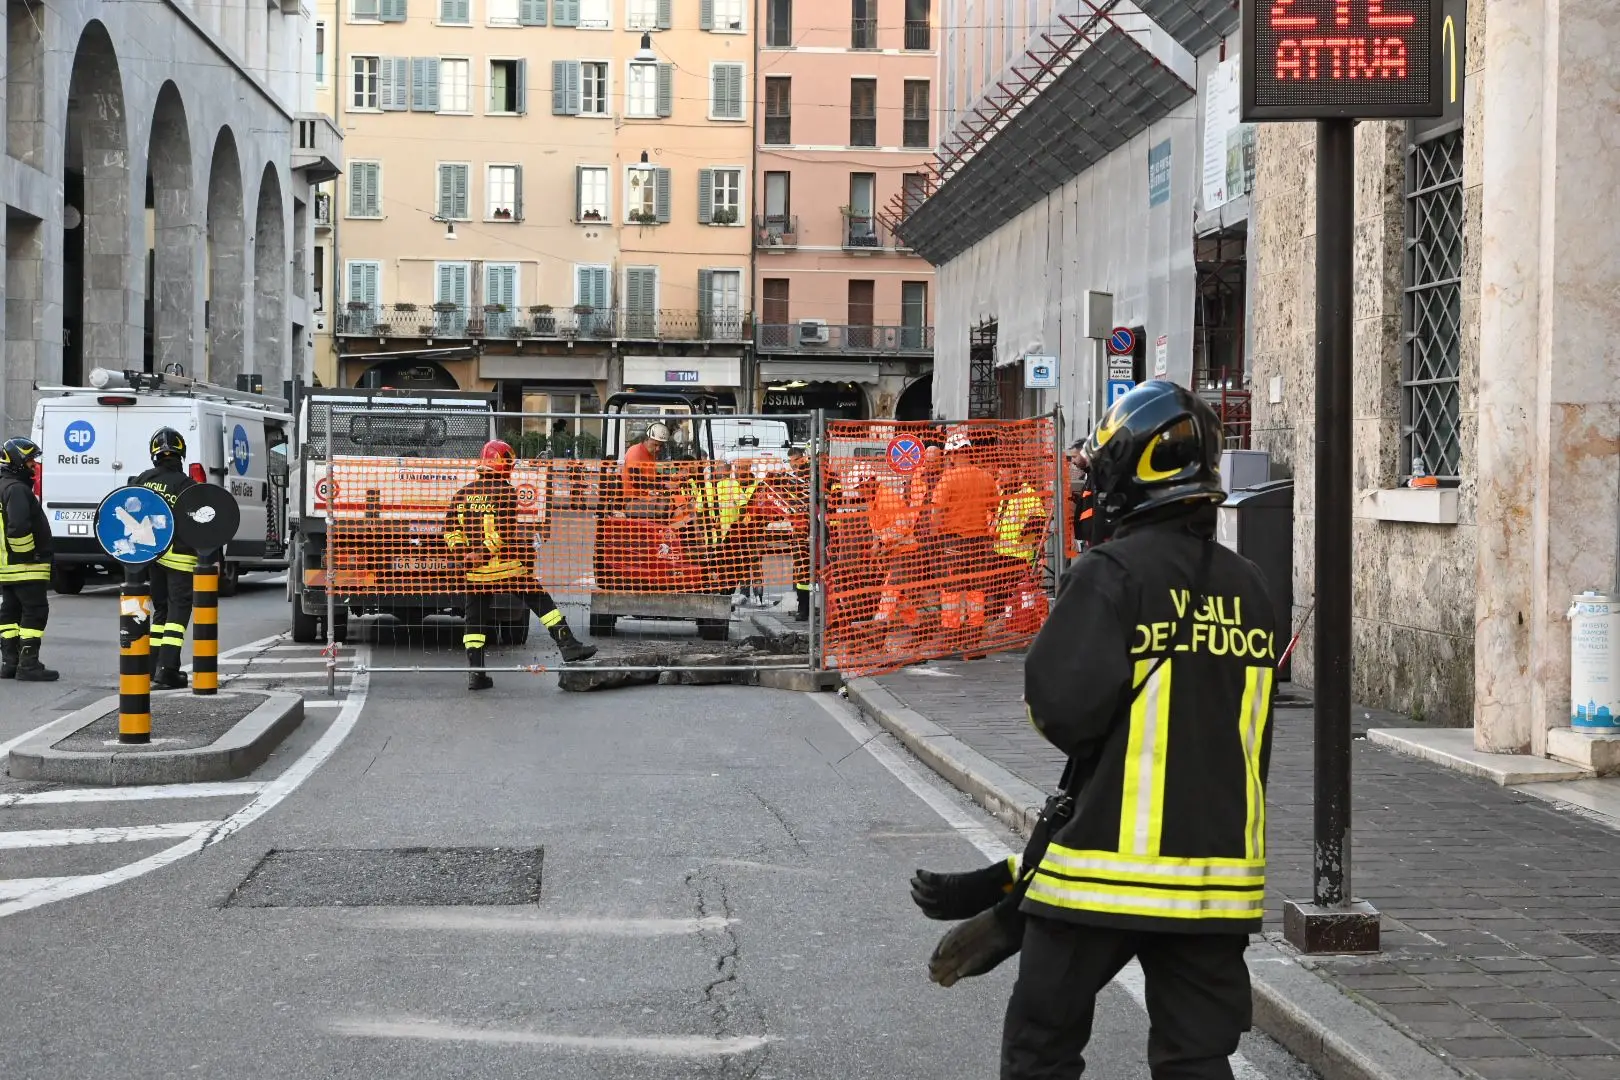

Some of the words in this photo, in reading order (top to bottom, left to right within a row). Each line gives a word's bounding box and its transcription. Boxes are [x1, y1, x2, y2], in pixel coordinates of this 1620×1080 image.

[1277, 38, 1407, 79] ATTIVA
[679, 371, 697, 381] TIM
[1113, 384, 1130, 404] P
[69, 430, 91, 447] ap
[58, 454, 78, 464] Reti
[81, 454, 100, 465] Gas
[231, 481, 242, 497] Reti
[242, 482, 253, 497] Gas
